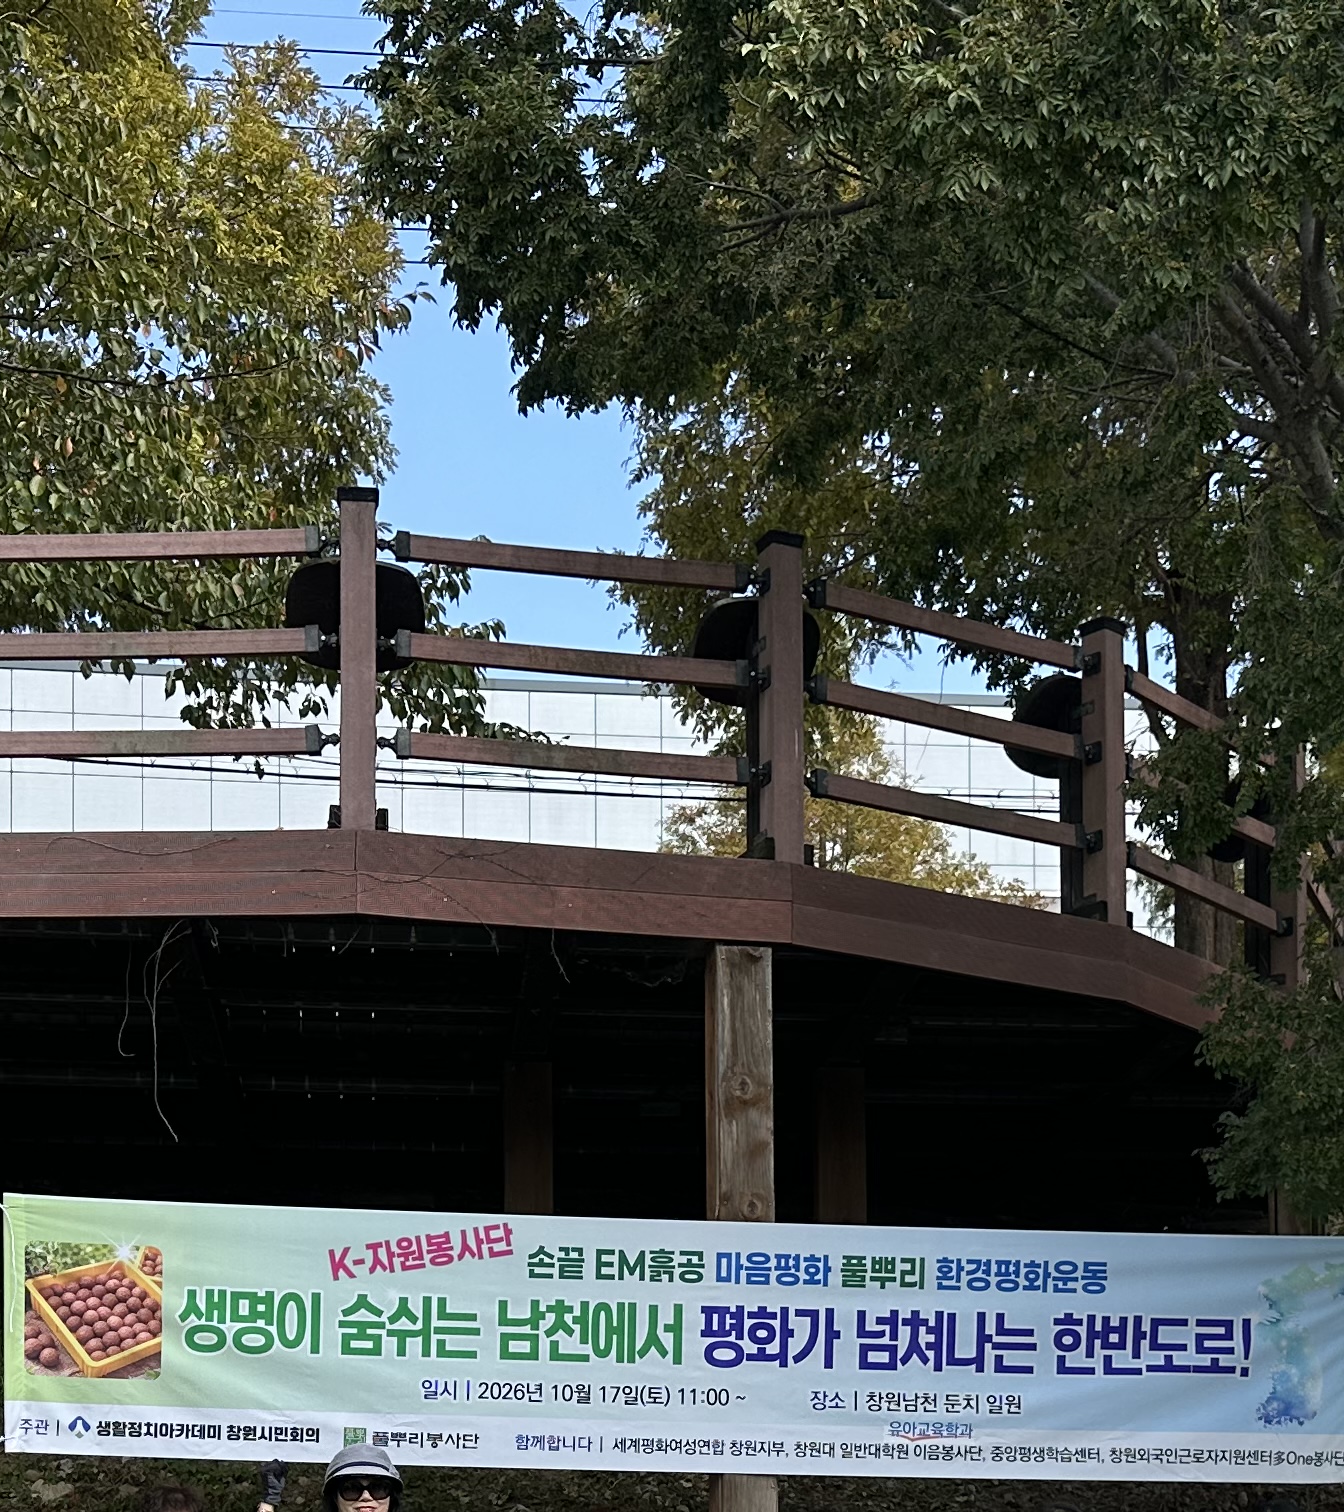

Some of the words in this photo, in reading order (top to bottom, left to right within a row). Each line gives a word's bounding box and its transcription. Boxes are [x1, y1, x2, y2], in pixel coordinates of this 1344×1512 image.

[328, 1223, 514, 1281] K-자원봉사단
[526, 1244, 585, 1280] 손끝
[594, 1248, 705, 1283] EM흙공
[715, 1252, 831, 1287] 마음평화
[840, 1254, 925, 1290] 풀뿌리
[935, 1257, 1108, 1294] 환경평화운동
[177, 1287, 322, 1355] 생명이
[337, 1293, 482, 1360] 숨쉬는
[496, 1298, 684, 1366] 남천에서
[699, 1305, 841, 1370] 평화가
[856, 1308, 1038, 1375] 넘쳐나는
[1052, 1313, 1253, 1378] 한반도로!
[421, 1379, 458, 1400] 일시
[477, 1381, 544, 1403] 2026년
[551, 1384, 592, 1405] 10월
[598, 1385, 671, 1407] 17일(토)
[677, 1387, 730, 1406] 11:00
[809, 1390, 847, 1411] 장소
[864, 1391, 939, 1413] 창원남천
[943, 1393, 980, 1415] 둔치
[986, 1394, 1023, 1415] 일원
[18, 1418, 50, 1436] 주관
[96, 1420, 222, 1441] 생활정치아카데미
[226, 1424, 320, 1444] 창원시민회의
[372, 1430, 480, 1450] 풀뿌리봉사단
[888, 1421, 974, 1439] 유아교육학과
[515, 1434, 593, 1453] 함께합니다
[612, 1436, 726, 1455] 세계평화여성연합
[729, 1439, 789, 1459] 창원지부,
[794, 1441, 835, 1459] 창원대
[840, 1443, 909, 1461] 일반대학원
[913, 1444, 986, 1463] 이음봉사단,
[990, 1445, 1105, 1465] 중앙평생학습센터,
